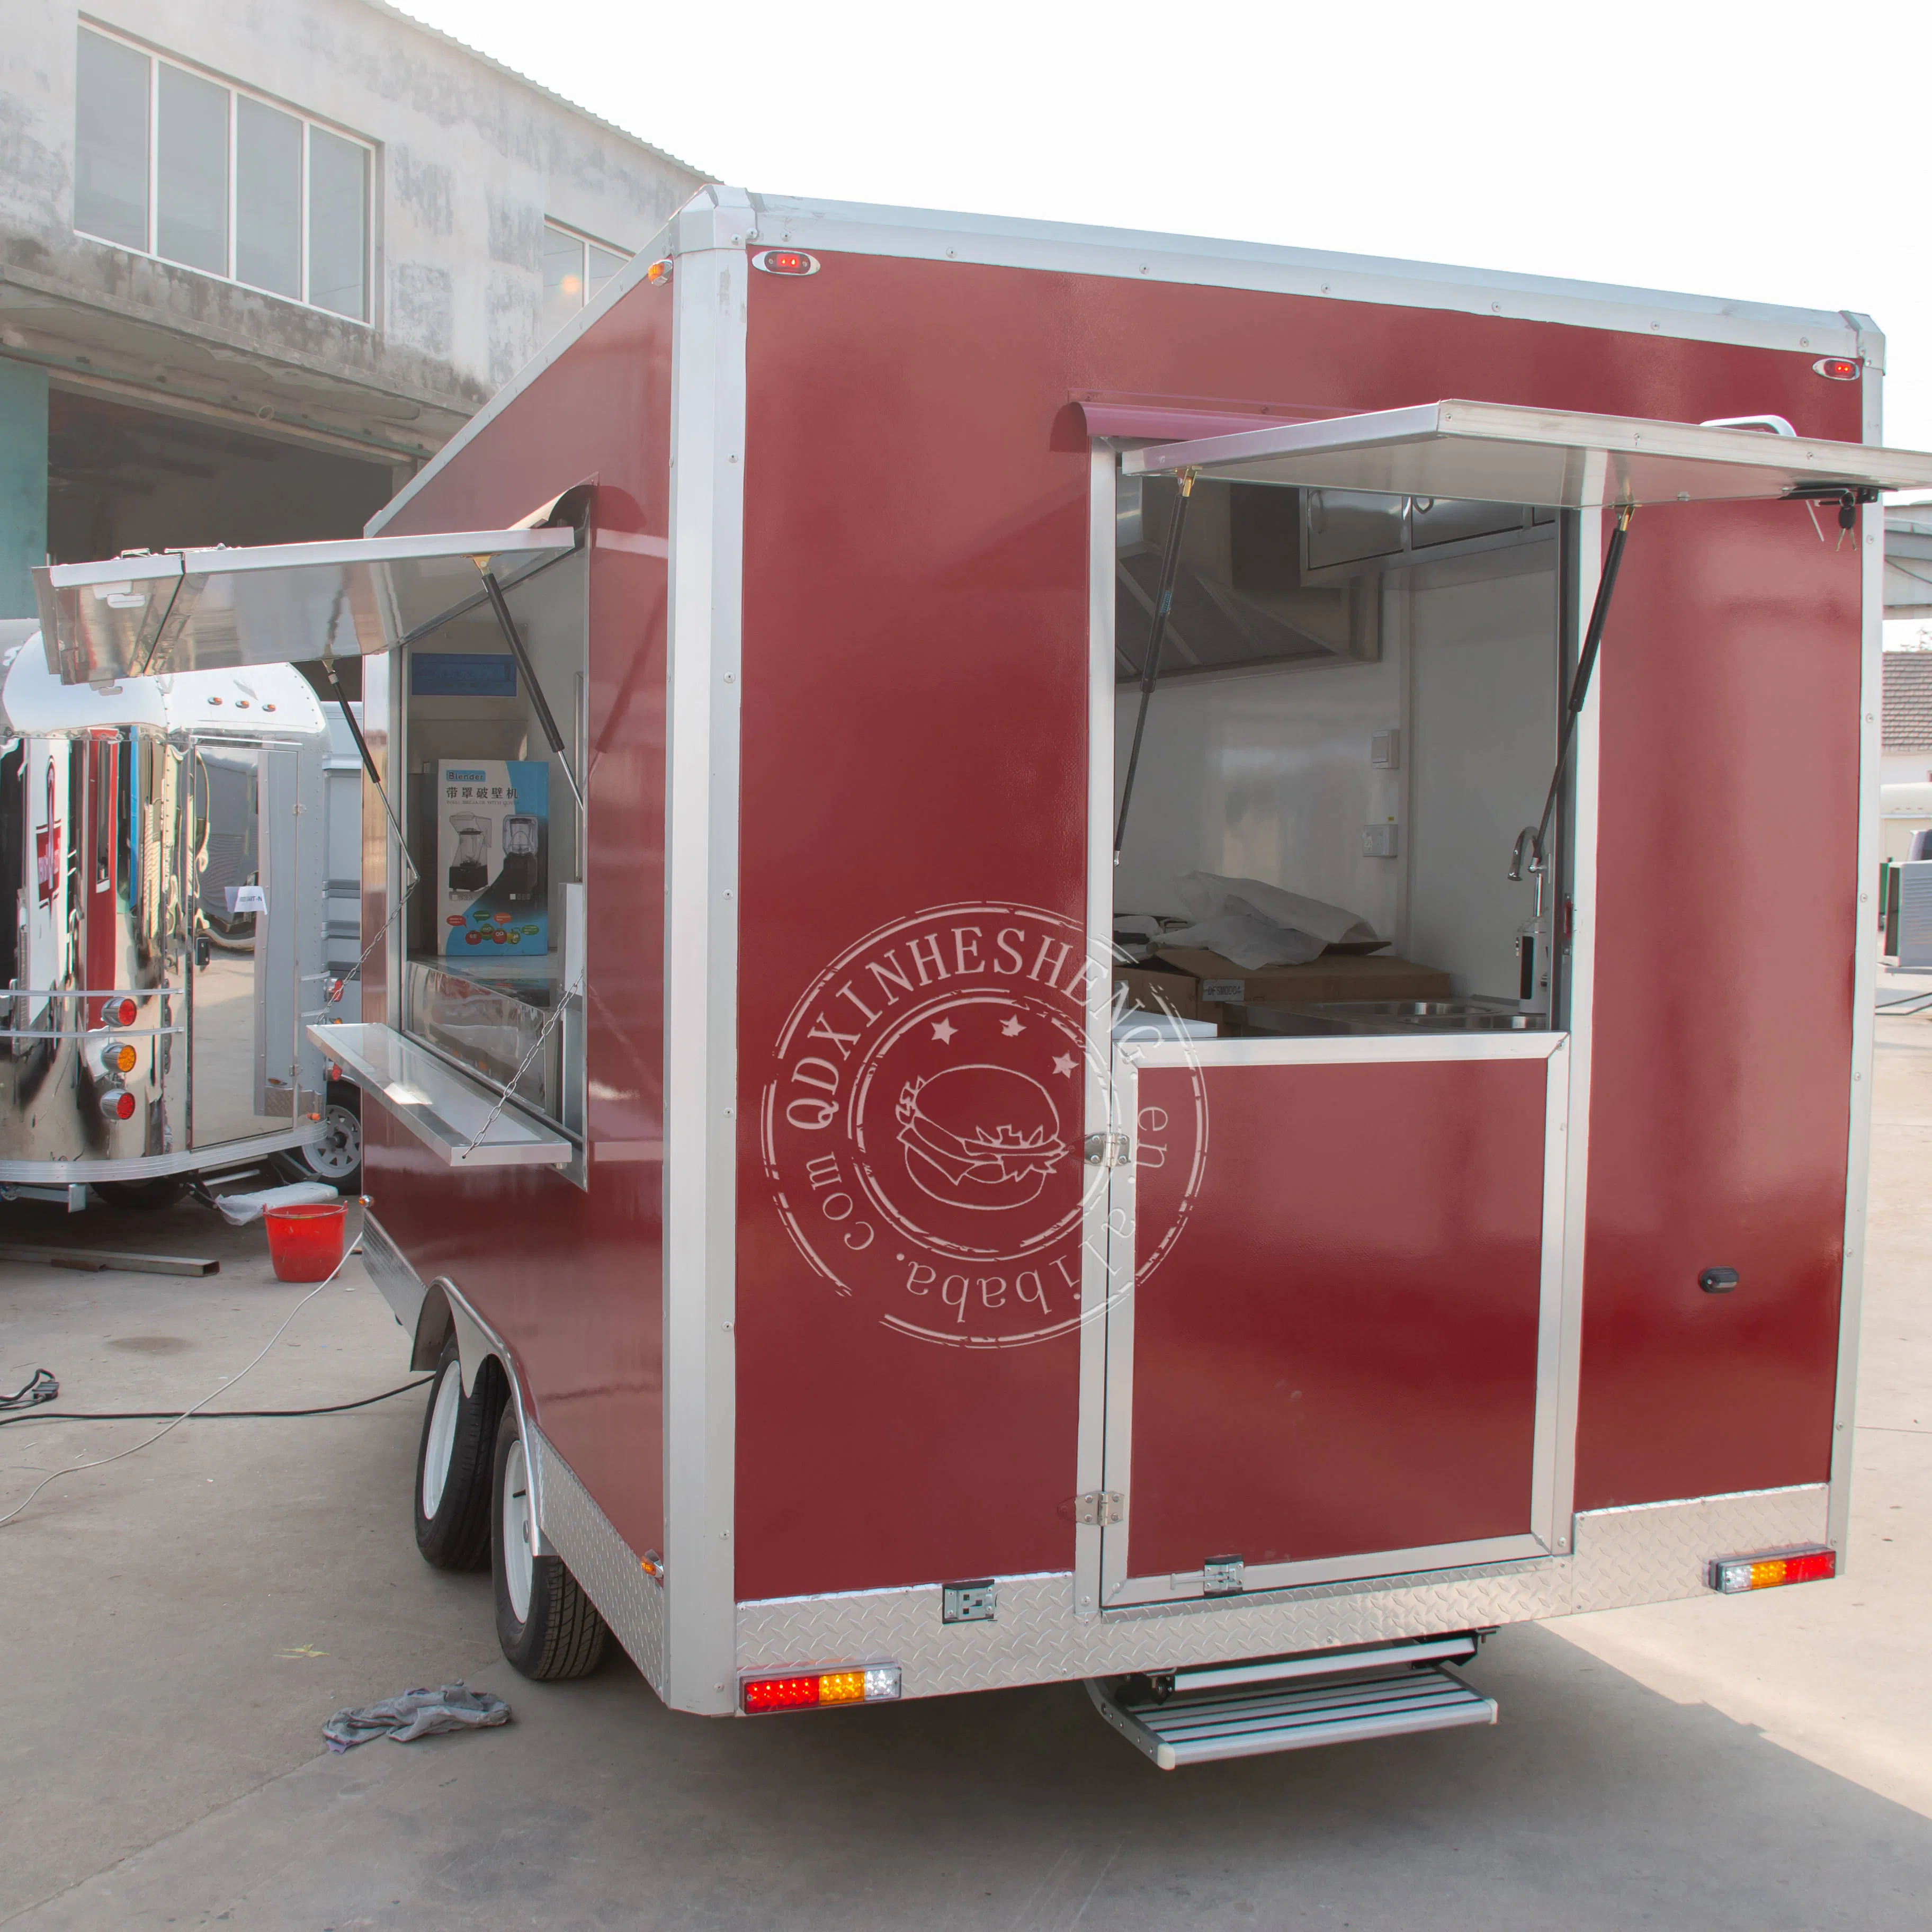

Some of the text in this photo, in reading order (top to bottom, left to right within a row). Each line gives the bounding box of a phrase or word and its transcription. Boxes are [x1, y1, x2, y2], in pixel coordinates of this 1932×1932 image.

[449, 772, 484, 780] Blender
[446, 786, 518, 799] 带罩破壁机
